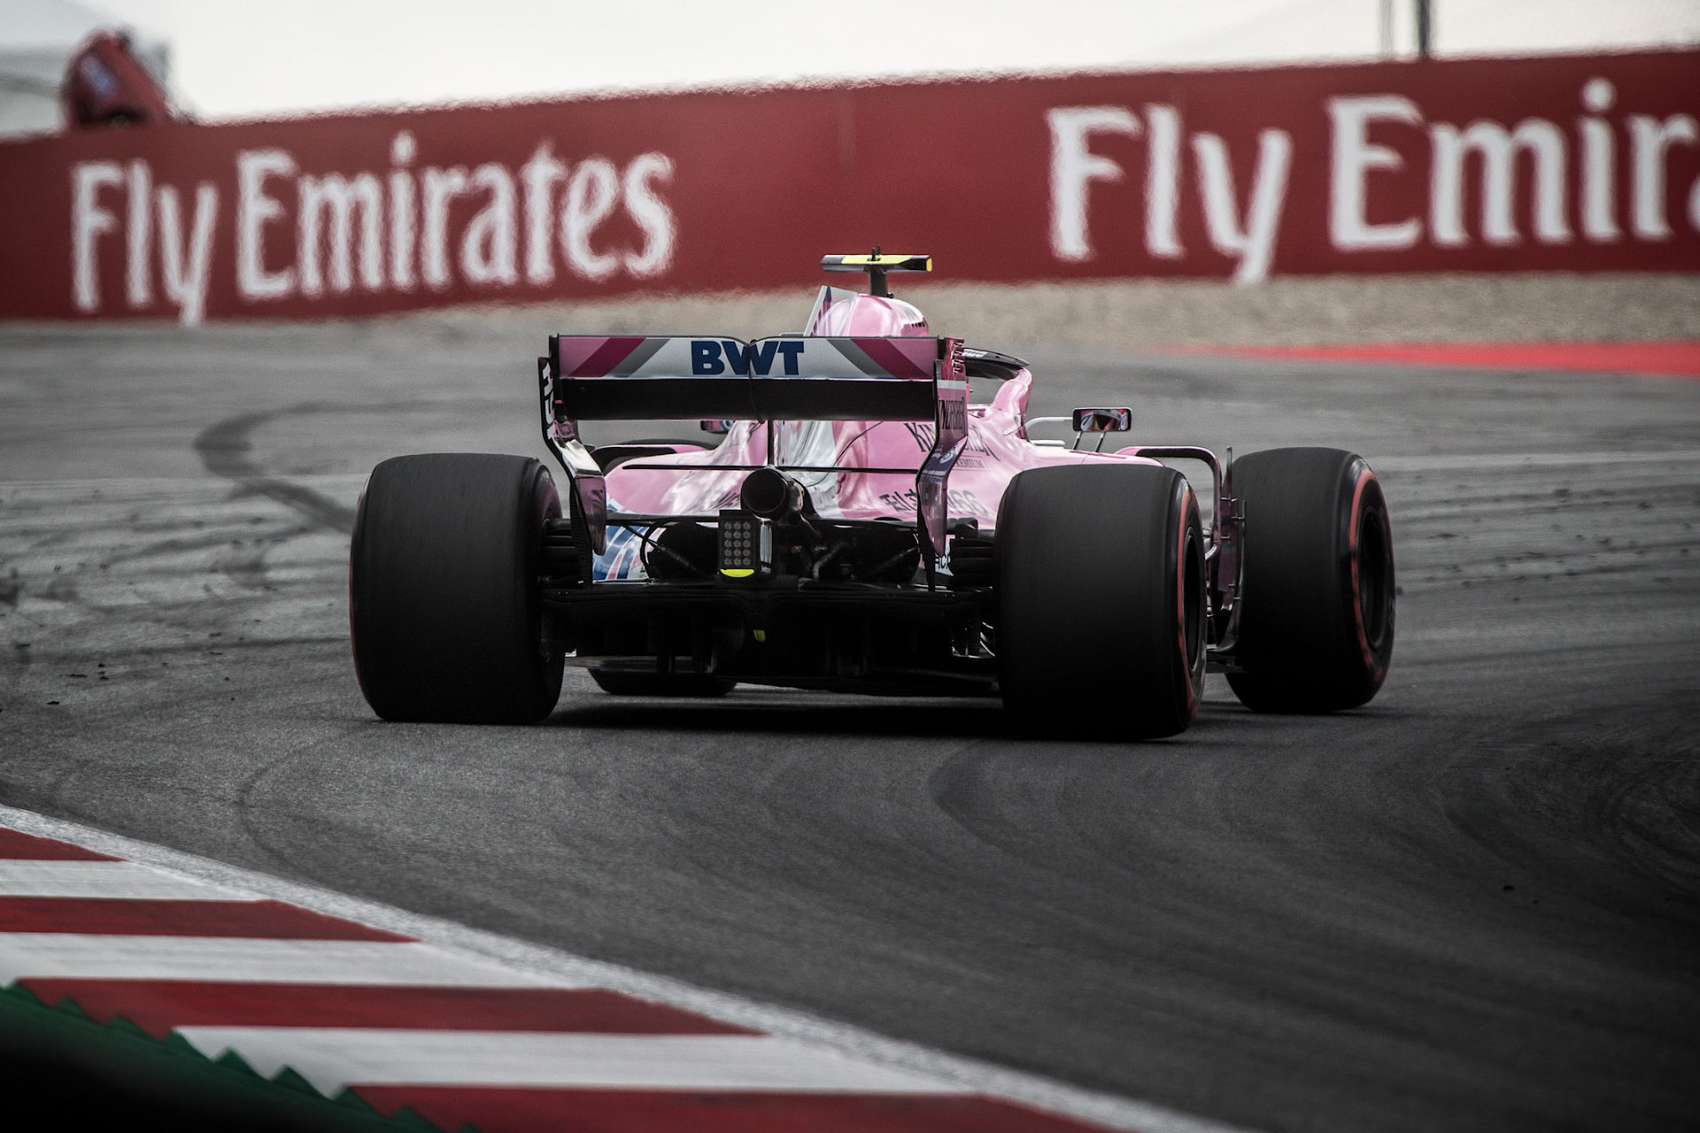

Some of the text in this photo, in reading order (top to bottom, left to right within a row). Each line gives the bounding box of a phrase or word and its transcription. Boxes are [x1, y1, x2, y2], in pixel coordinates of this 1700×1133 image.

[73, 131, 676, 326] Fly Emirates
[1047, 78, 1700, 285] Fly Emir
[691, 340, 804, 376] BWT
